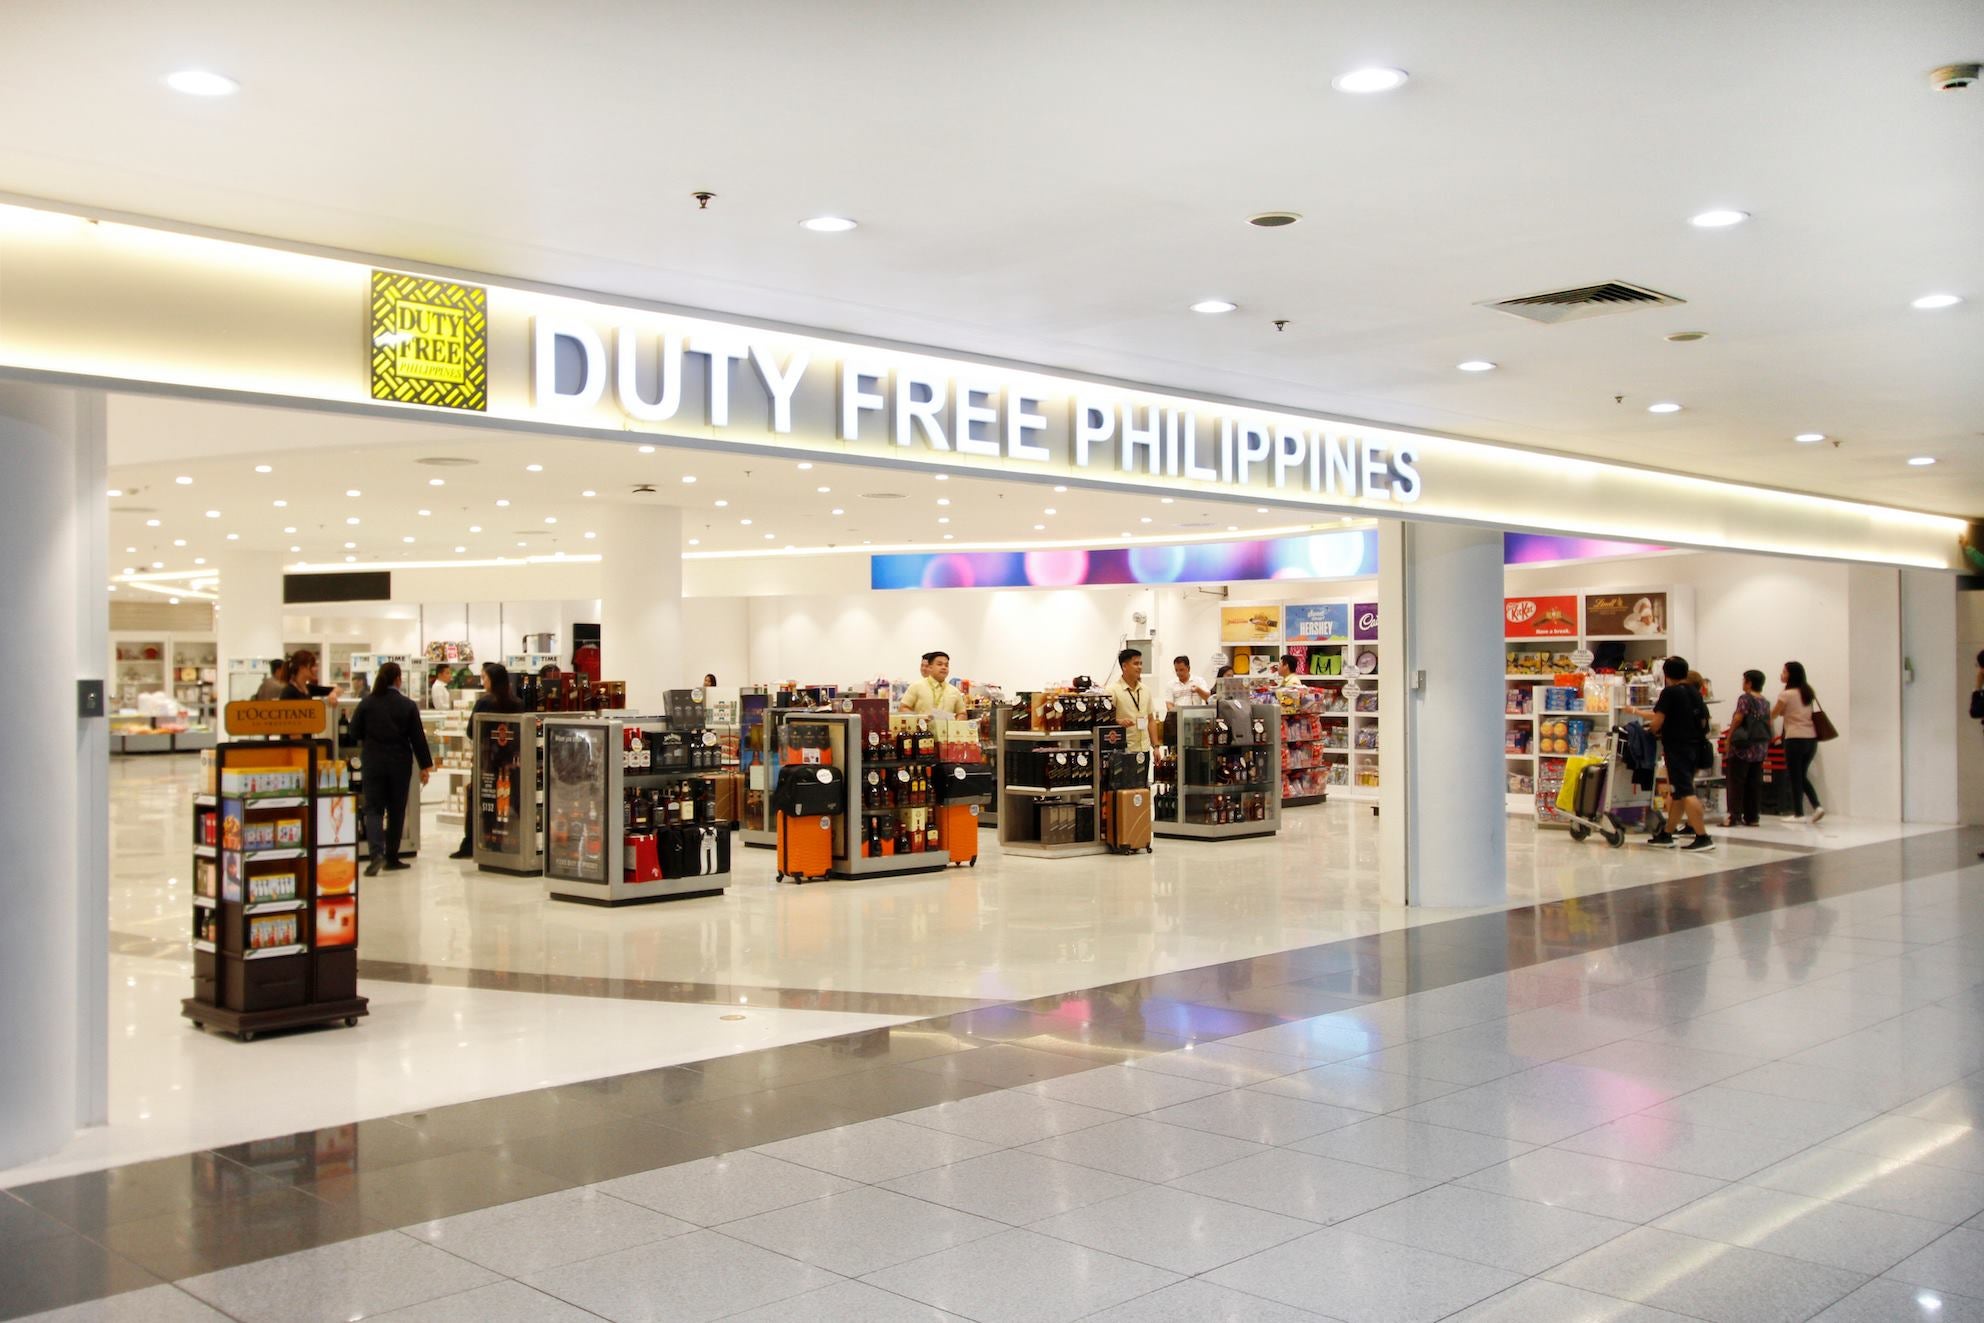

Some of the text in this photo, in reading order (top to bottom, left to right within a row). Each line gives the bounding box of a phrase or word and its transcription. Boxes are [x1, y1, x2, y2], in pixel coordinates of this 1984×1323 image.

[400, 306, 463, 338] DUTY
[399, 335, 461, 365] FREE
[399, 361, 462, 379] PHILIPPINES
[532, 315, 1421, 503] DUTY FREE PHILIPPINES
